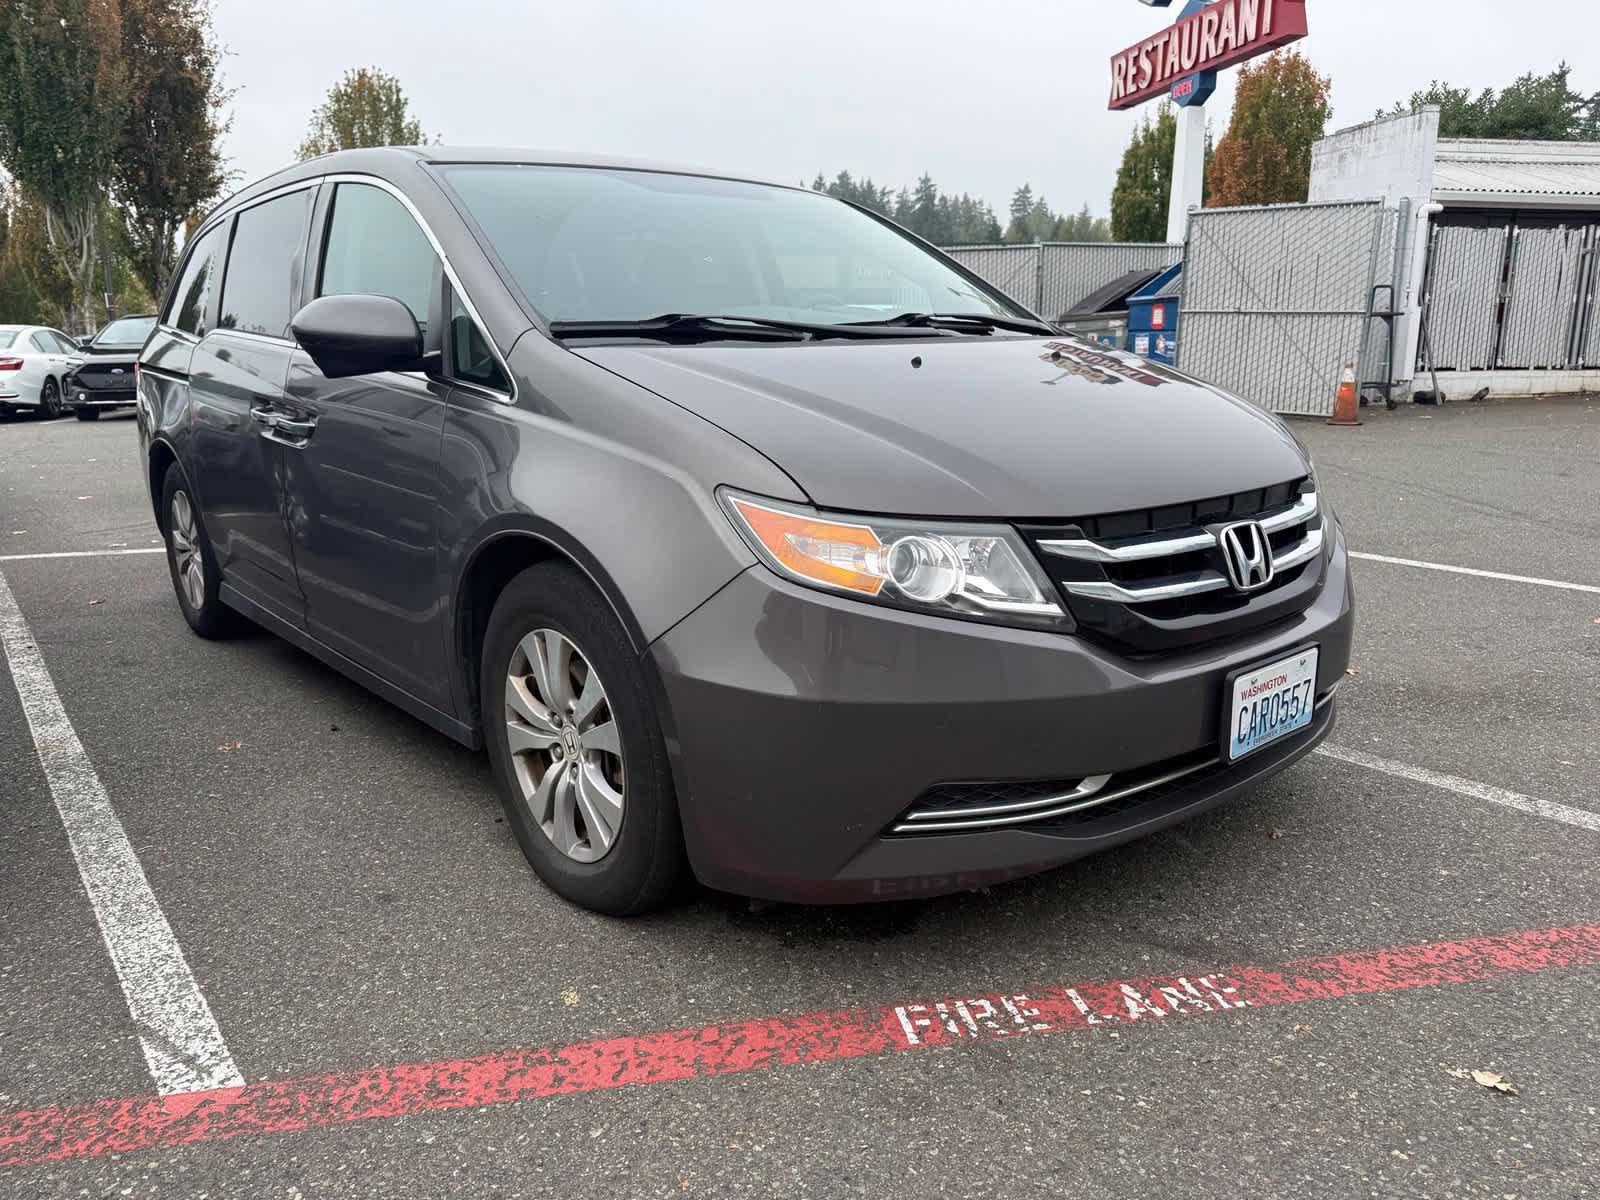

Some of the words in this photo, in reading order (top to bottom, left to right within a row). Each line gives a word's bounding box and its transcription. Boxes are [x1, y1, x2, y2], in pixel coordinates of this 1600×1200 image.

[1241, 673, 1288, 701] WASHINGTON
[895, 995, 1052, 1045] FIRE
[1065, 973, 1252, 1025] LANE
